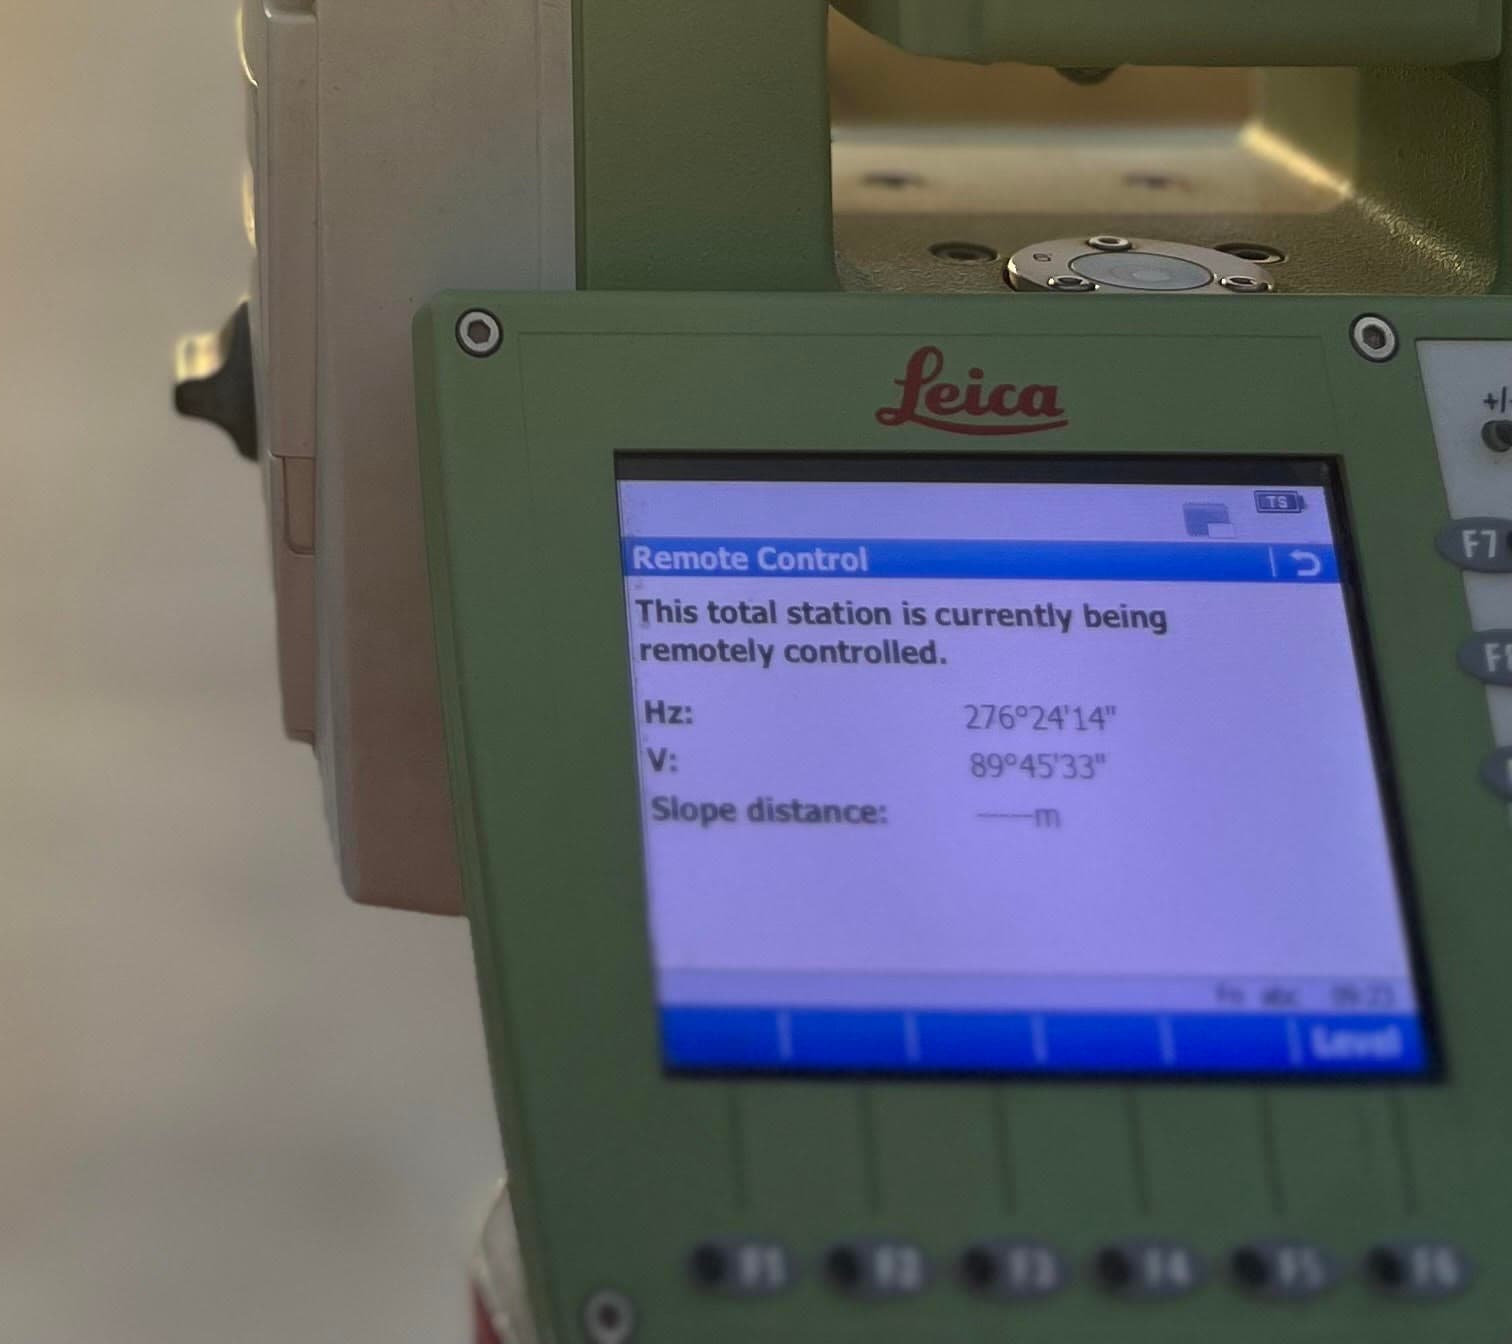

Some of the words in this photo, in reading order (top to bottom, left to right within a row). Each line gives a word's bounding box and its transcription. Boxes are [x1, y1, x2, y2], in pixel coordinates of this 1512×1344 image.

[874, 345, 1069, 436] Leica
[632, 545, 750, 570] Remote
[756, 546, 869, 572] Control
[1461, 529, 1497, 559] F7
[635, 599, 699, 624] This
[708, 600, 778, 625] total
[786, 600, 892, 626] station
[902, 601, 928, 626] is
[935, 602, 1073, 633] currently
[1082, 603, 1168, 635] being
[639, 638, 774, 669] remotely
[783, 639, 948, 664] controlled.
[644, 700, 693, 725] Hz:
[646, 747, 679, 773] V:
[650, 796, 737, 828] Slope
[746, 798, 889, 824] distance:
